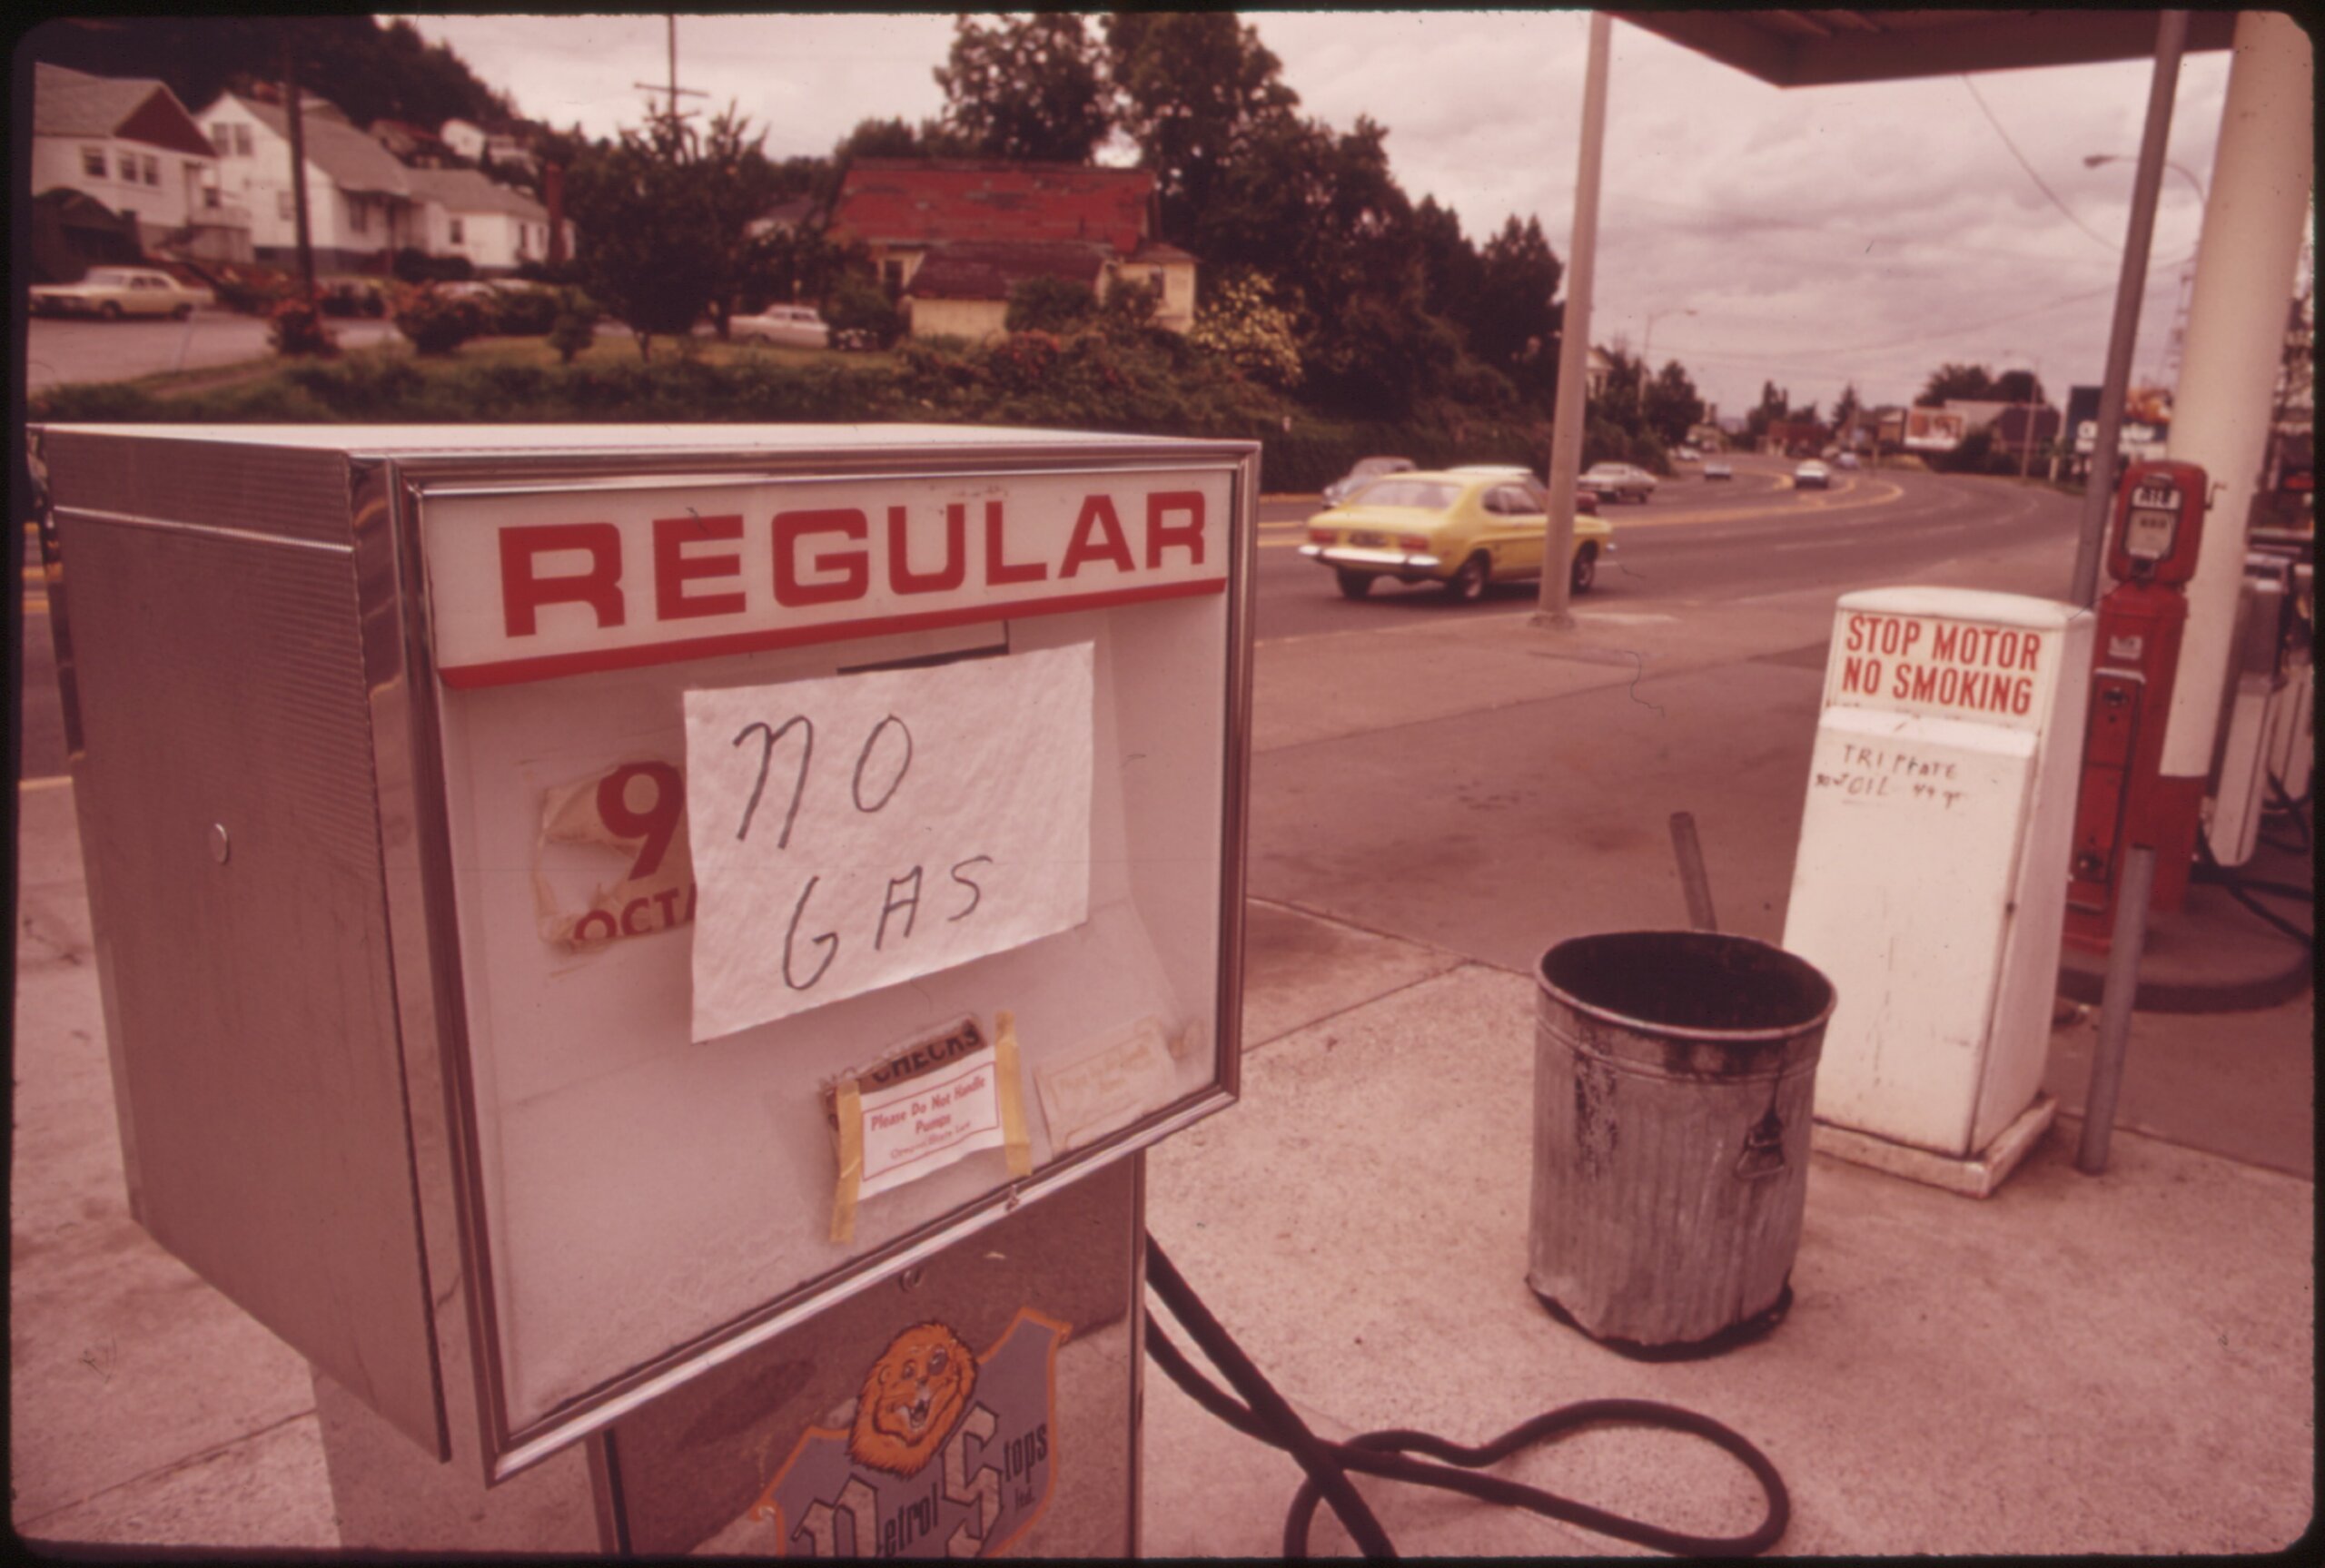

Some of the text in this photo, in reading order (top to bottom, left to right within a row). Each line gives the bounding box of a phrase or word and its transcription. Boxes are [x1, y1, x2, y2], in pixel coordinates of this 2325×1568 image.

[498, 490, 1206, 637] REGULAR
[1845, 615, 2042, 672] STOP MOTOR
[1841, 656, 2033, 715] NO SMOKING
[733, 715, 913, 850] NO
[782, 854, 994, 991] GAS
[869, 1075, 985, 1132] Please Do Not Handle
[915, 1113, 952, 1134] Pumps
